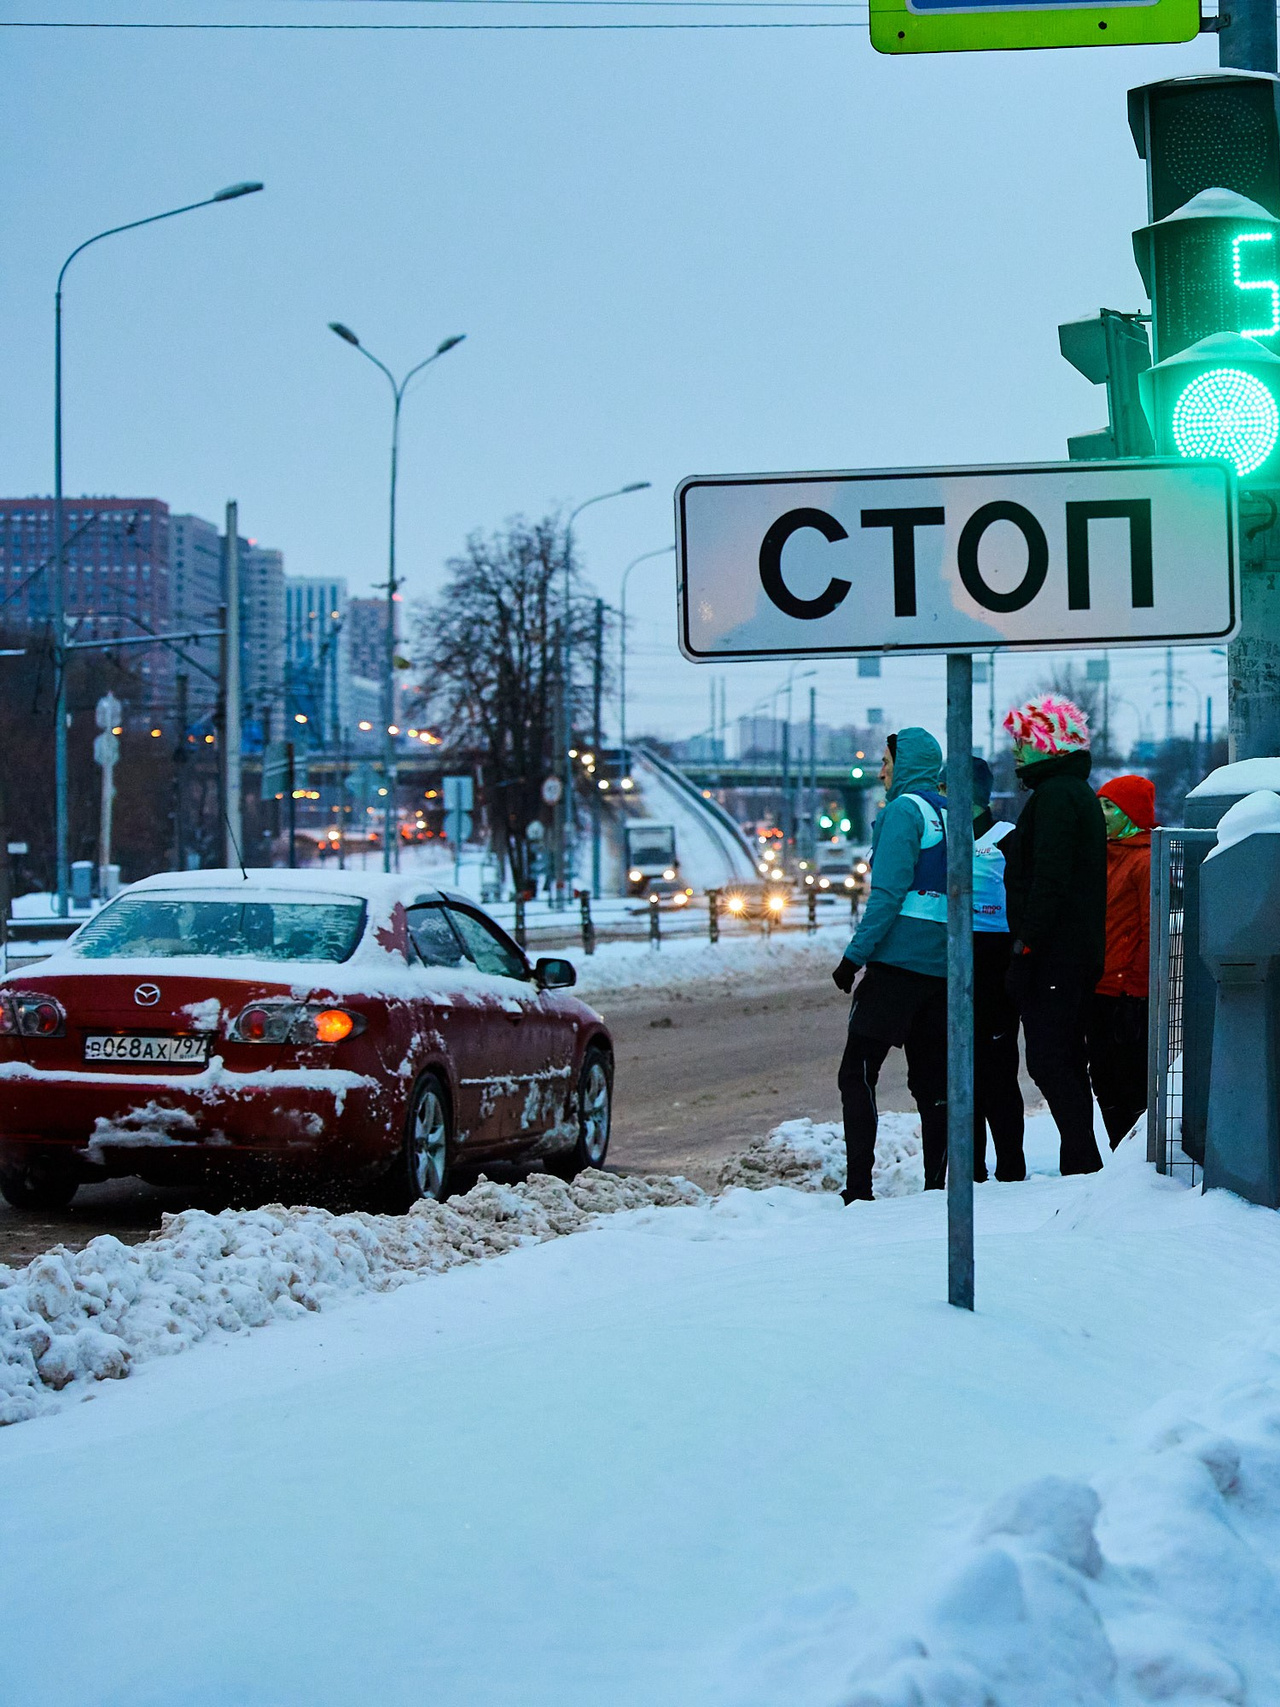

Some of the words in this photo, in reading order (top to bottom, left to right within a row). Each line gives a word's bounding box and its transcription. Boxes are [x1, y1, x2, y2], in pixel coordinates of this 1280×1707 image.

[1232, 232, 1280, 338] 5
[759, 498, 1154, 620] СТОП
[174, 1038, 205, 1055] 797
